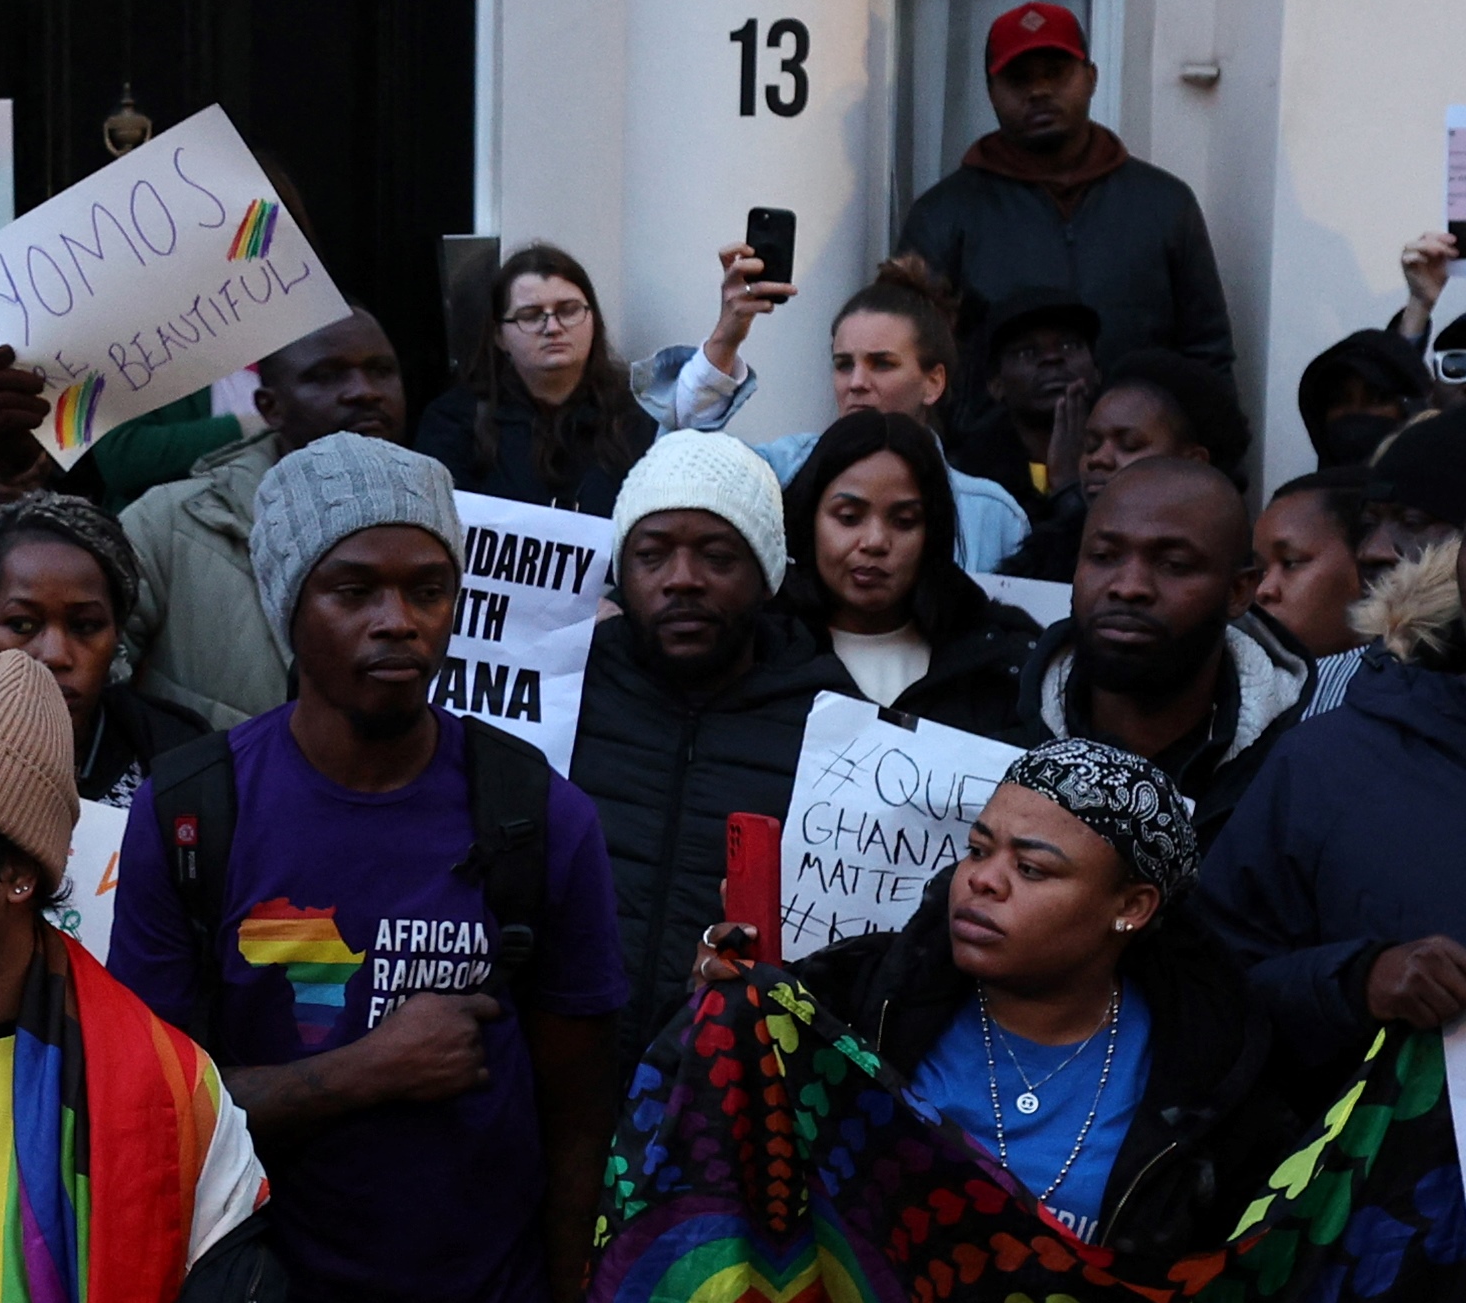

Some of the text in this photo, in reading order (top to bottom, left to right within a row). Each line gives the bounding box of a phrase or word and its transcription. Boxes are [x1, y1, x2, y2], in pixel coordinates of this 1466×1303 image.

[729, 17, 810, 118] 13
[31, 257, 311, 393] RE BEAUTIFUL
[464, 525, 596, 595] IDARITY
[452, 587, 510, 642] ITH
[436, 656, 541, 724] ANA
[797, 851, 932, 905] MATTE
[374, 917, 489, 955] AFRICAN
[372, 957, 492, 992] RAINBOW
